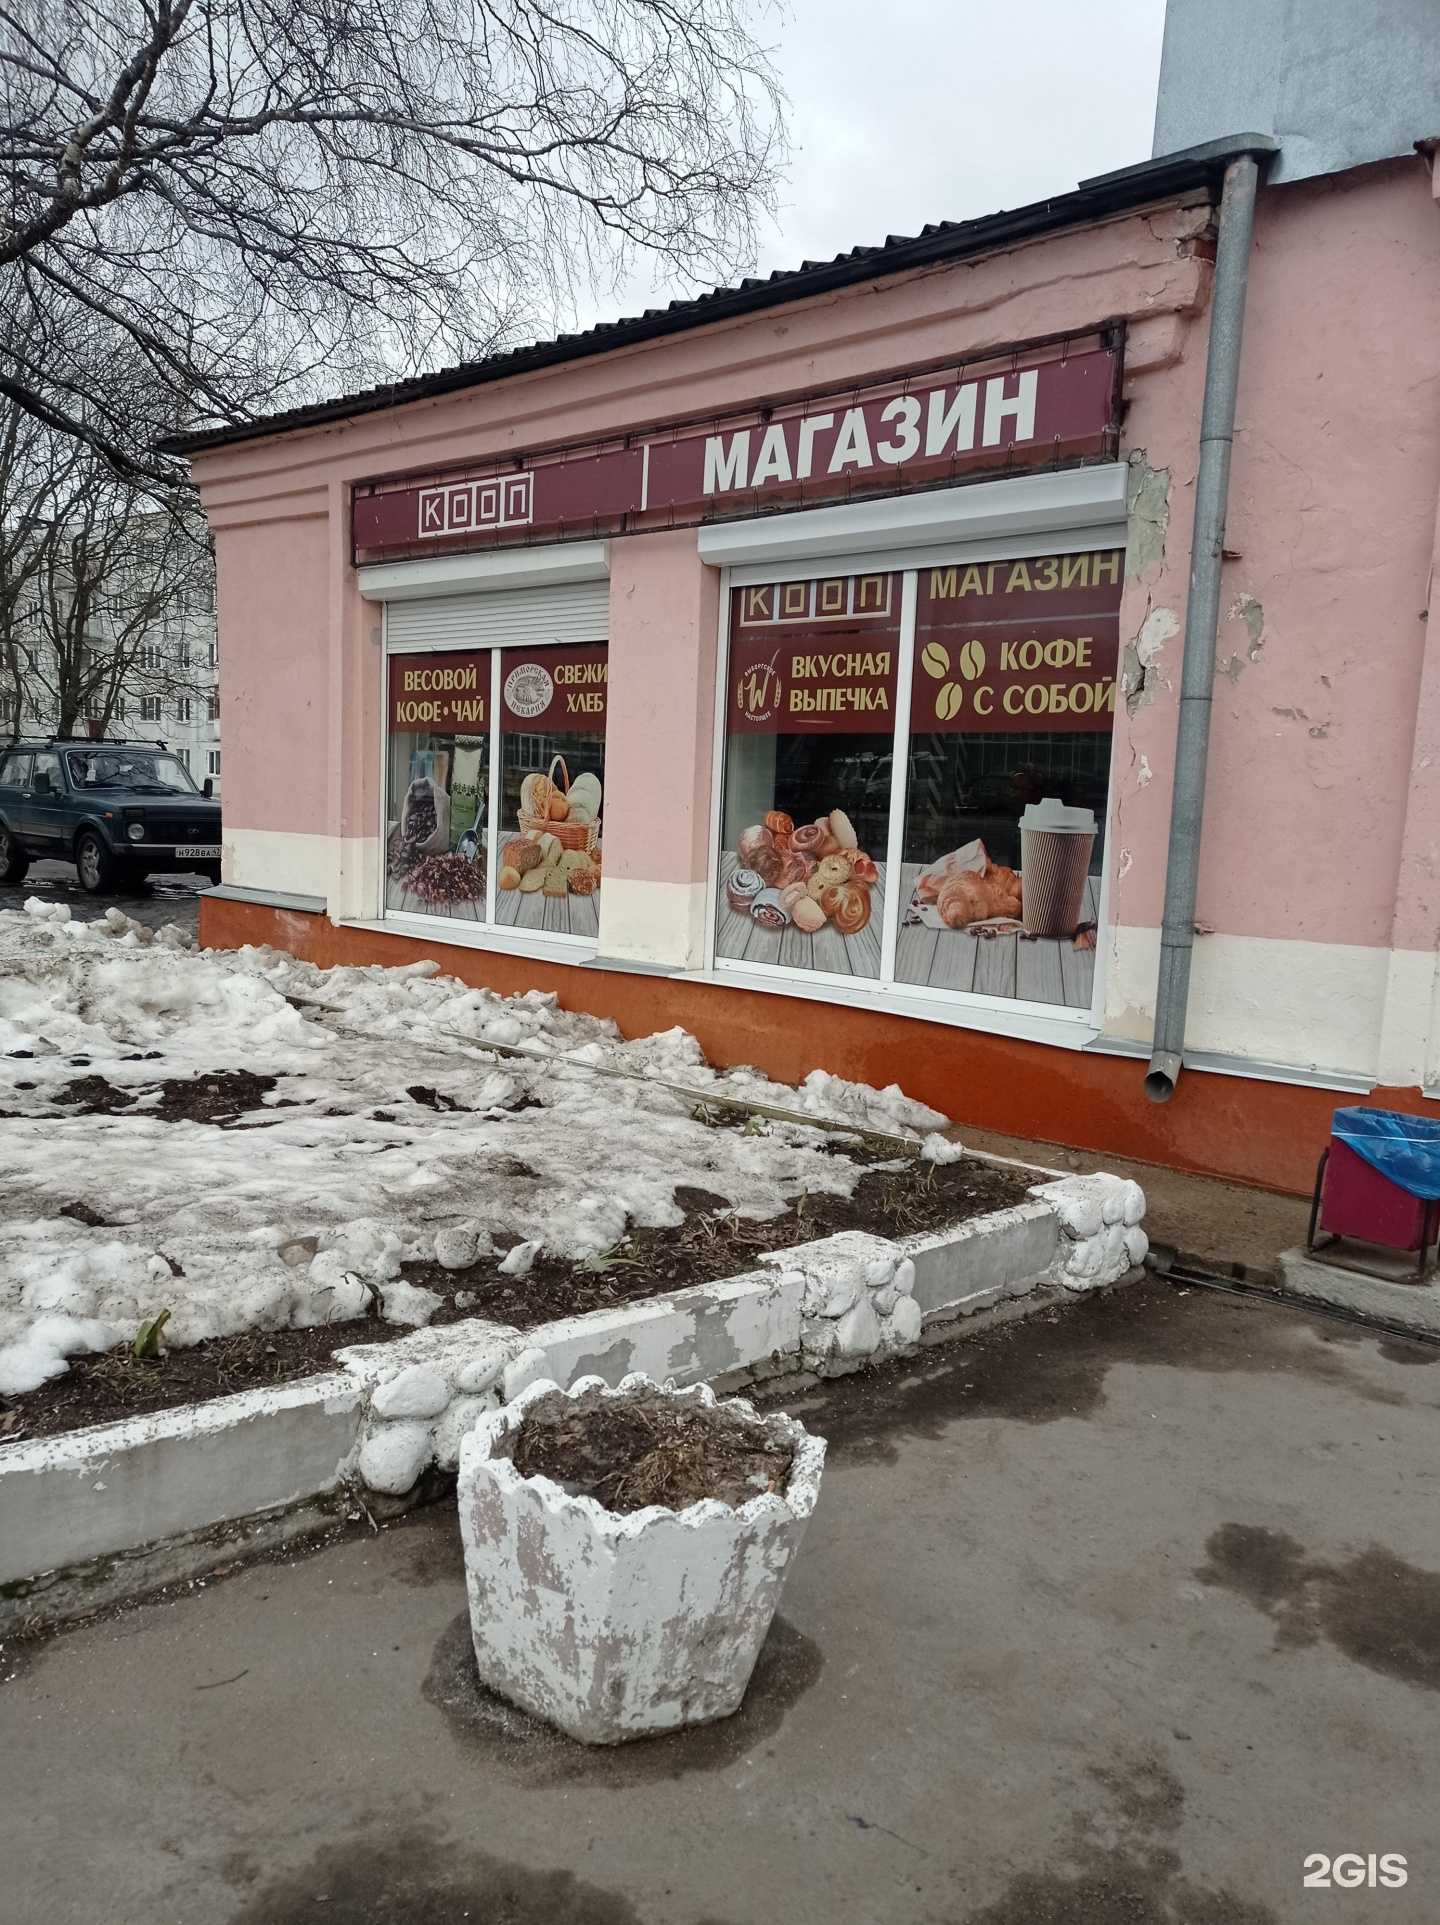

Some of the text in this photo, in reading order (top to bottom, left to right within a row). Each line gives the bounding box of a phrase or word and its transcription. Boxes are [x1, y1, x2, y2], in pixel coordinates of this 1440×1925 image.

[703, 370, 1039, 496] МАГАЗИН
[425, 484, 527, 527] КООП
[930, 552, 1119, 599] МАГАЗИН
[750, 576, 883, 616] КООП
[791, 652, 891, 679] ВКУСНАЯ
[1000, 637, 1093, 671] КОФЕ
[404, 664, 477, 691] ВЕСОВОЙ
[554, 664, 608, 685] СВЕЖИ
[566, 693, 604, 712] ХЛЕБ
[789, 687, 889, 712] ВЫПЕЧКА
[973, 676, 1116, 715] С СОБОЙ
